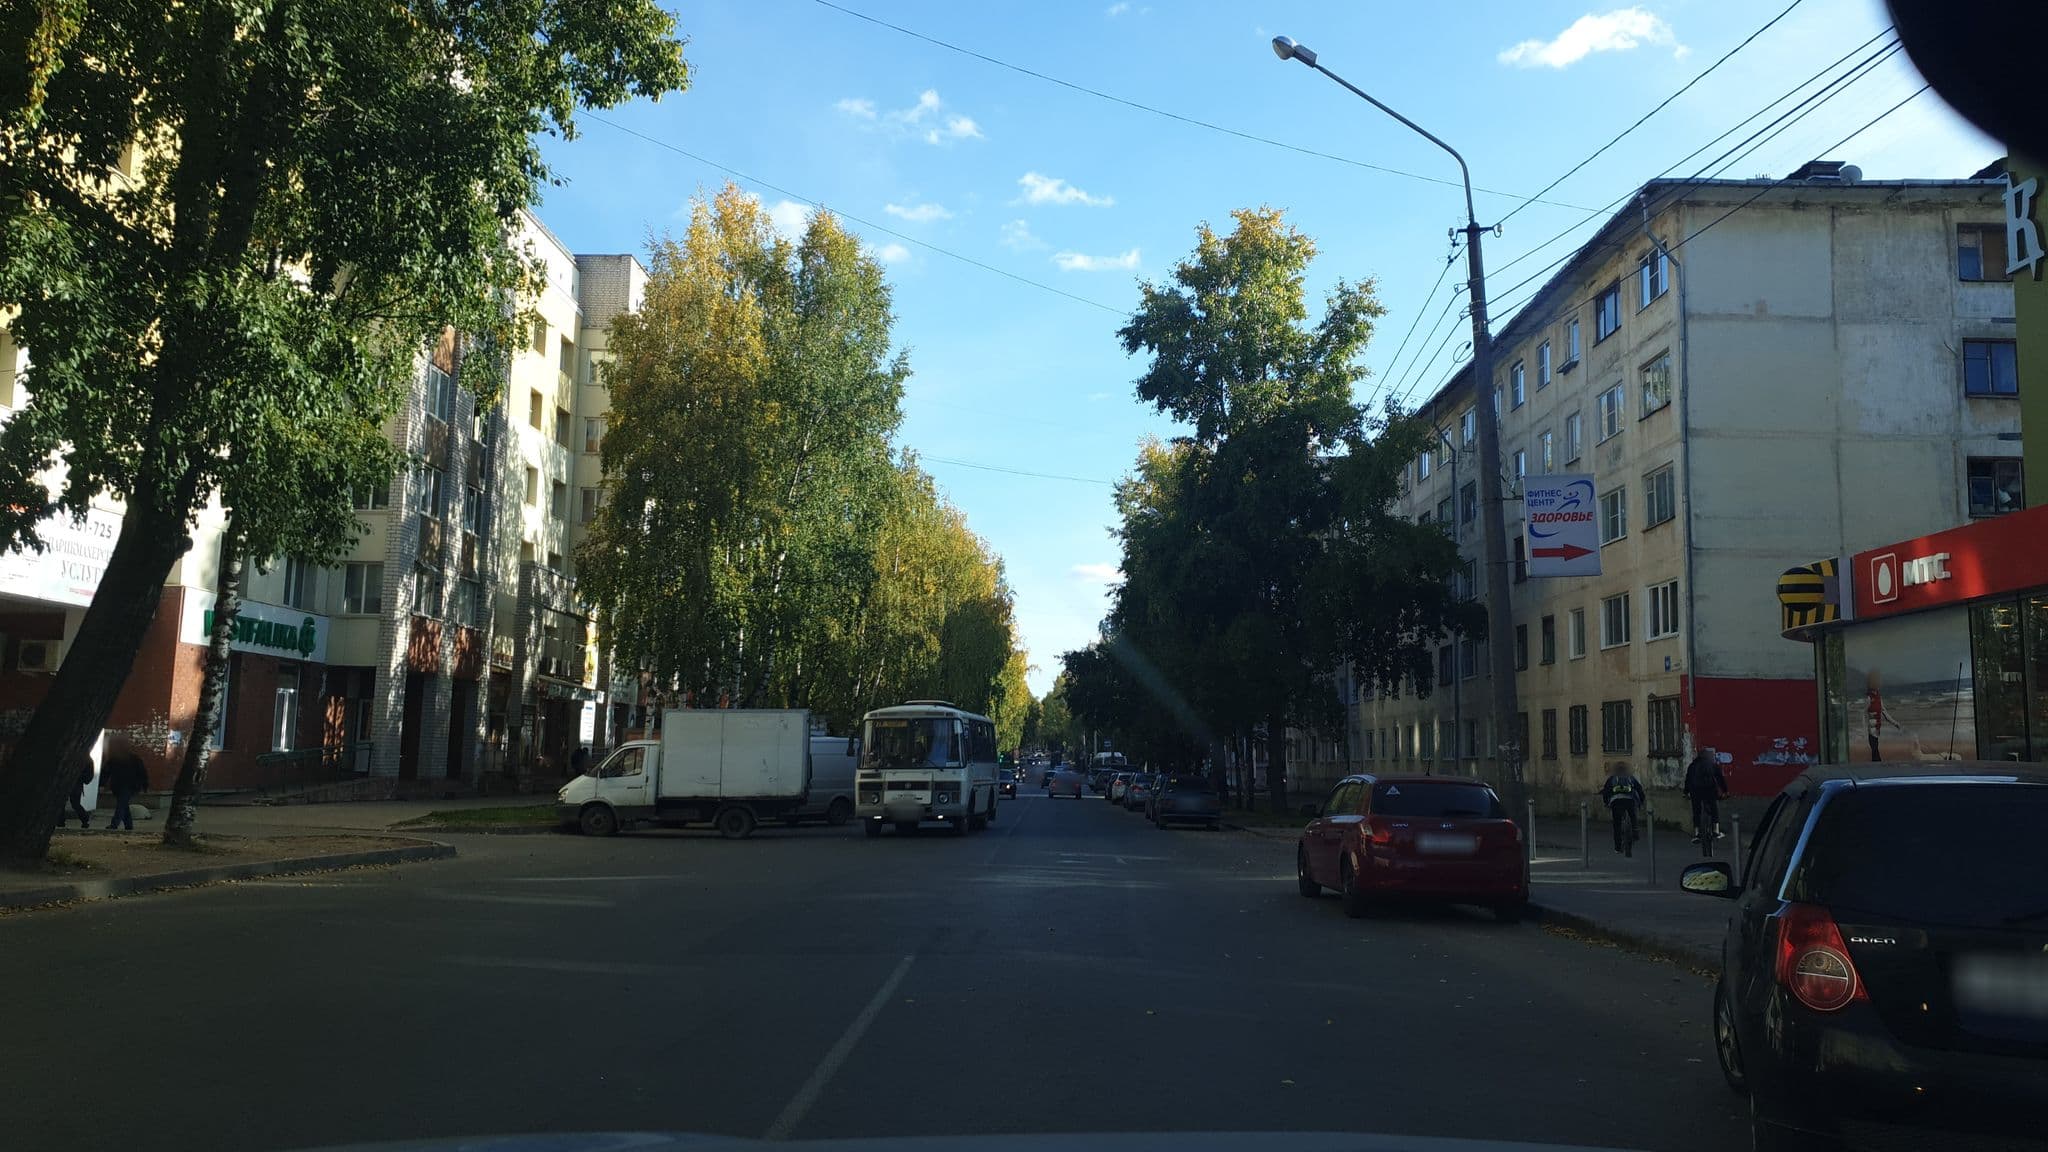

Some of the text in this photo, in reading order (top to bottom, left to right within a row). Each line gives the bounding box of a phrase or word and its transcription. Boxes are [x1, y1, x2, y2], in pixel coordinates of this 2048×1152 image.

[1527, 489, 1562, 498] ФИТНЕС
[1527, 499, 1555, 507] ЦЕНТР
[1531, 511, 1593, 523] ЗДОРОВЬЕ
[1903, 552, 1951, 587] МТС
